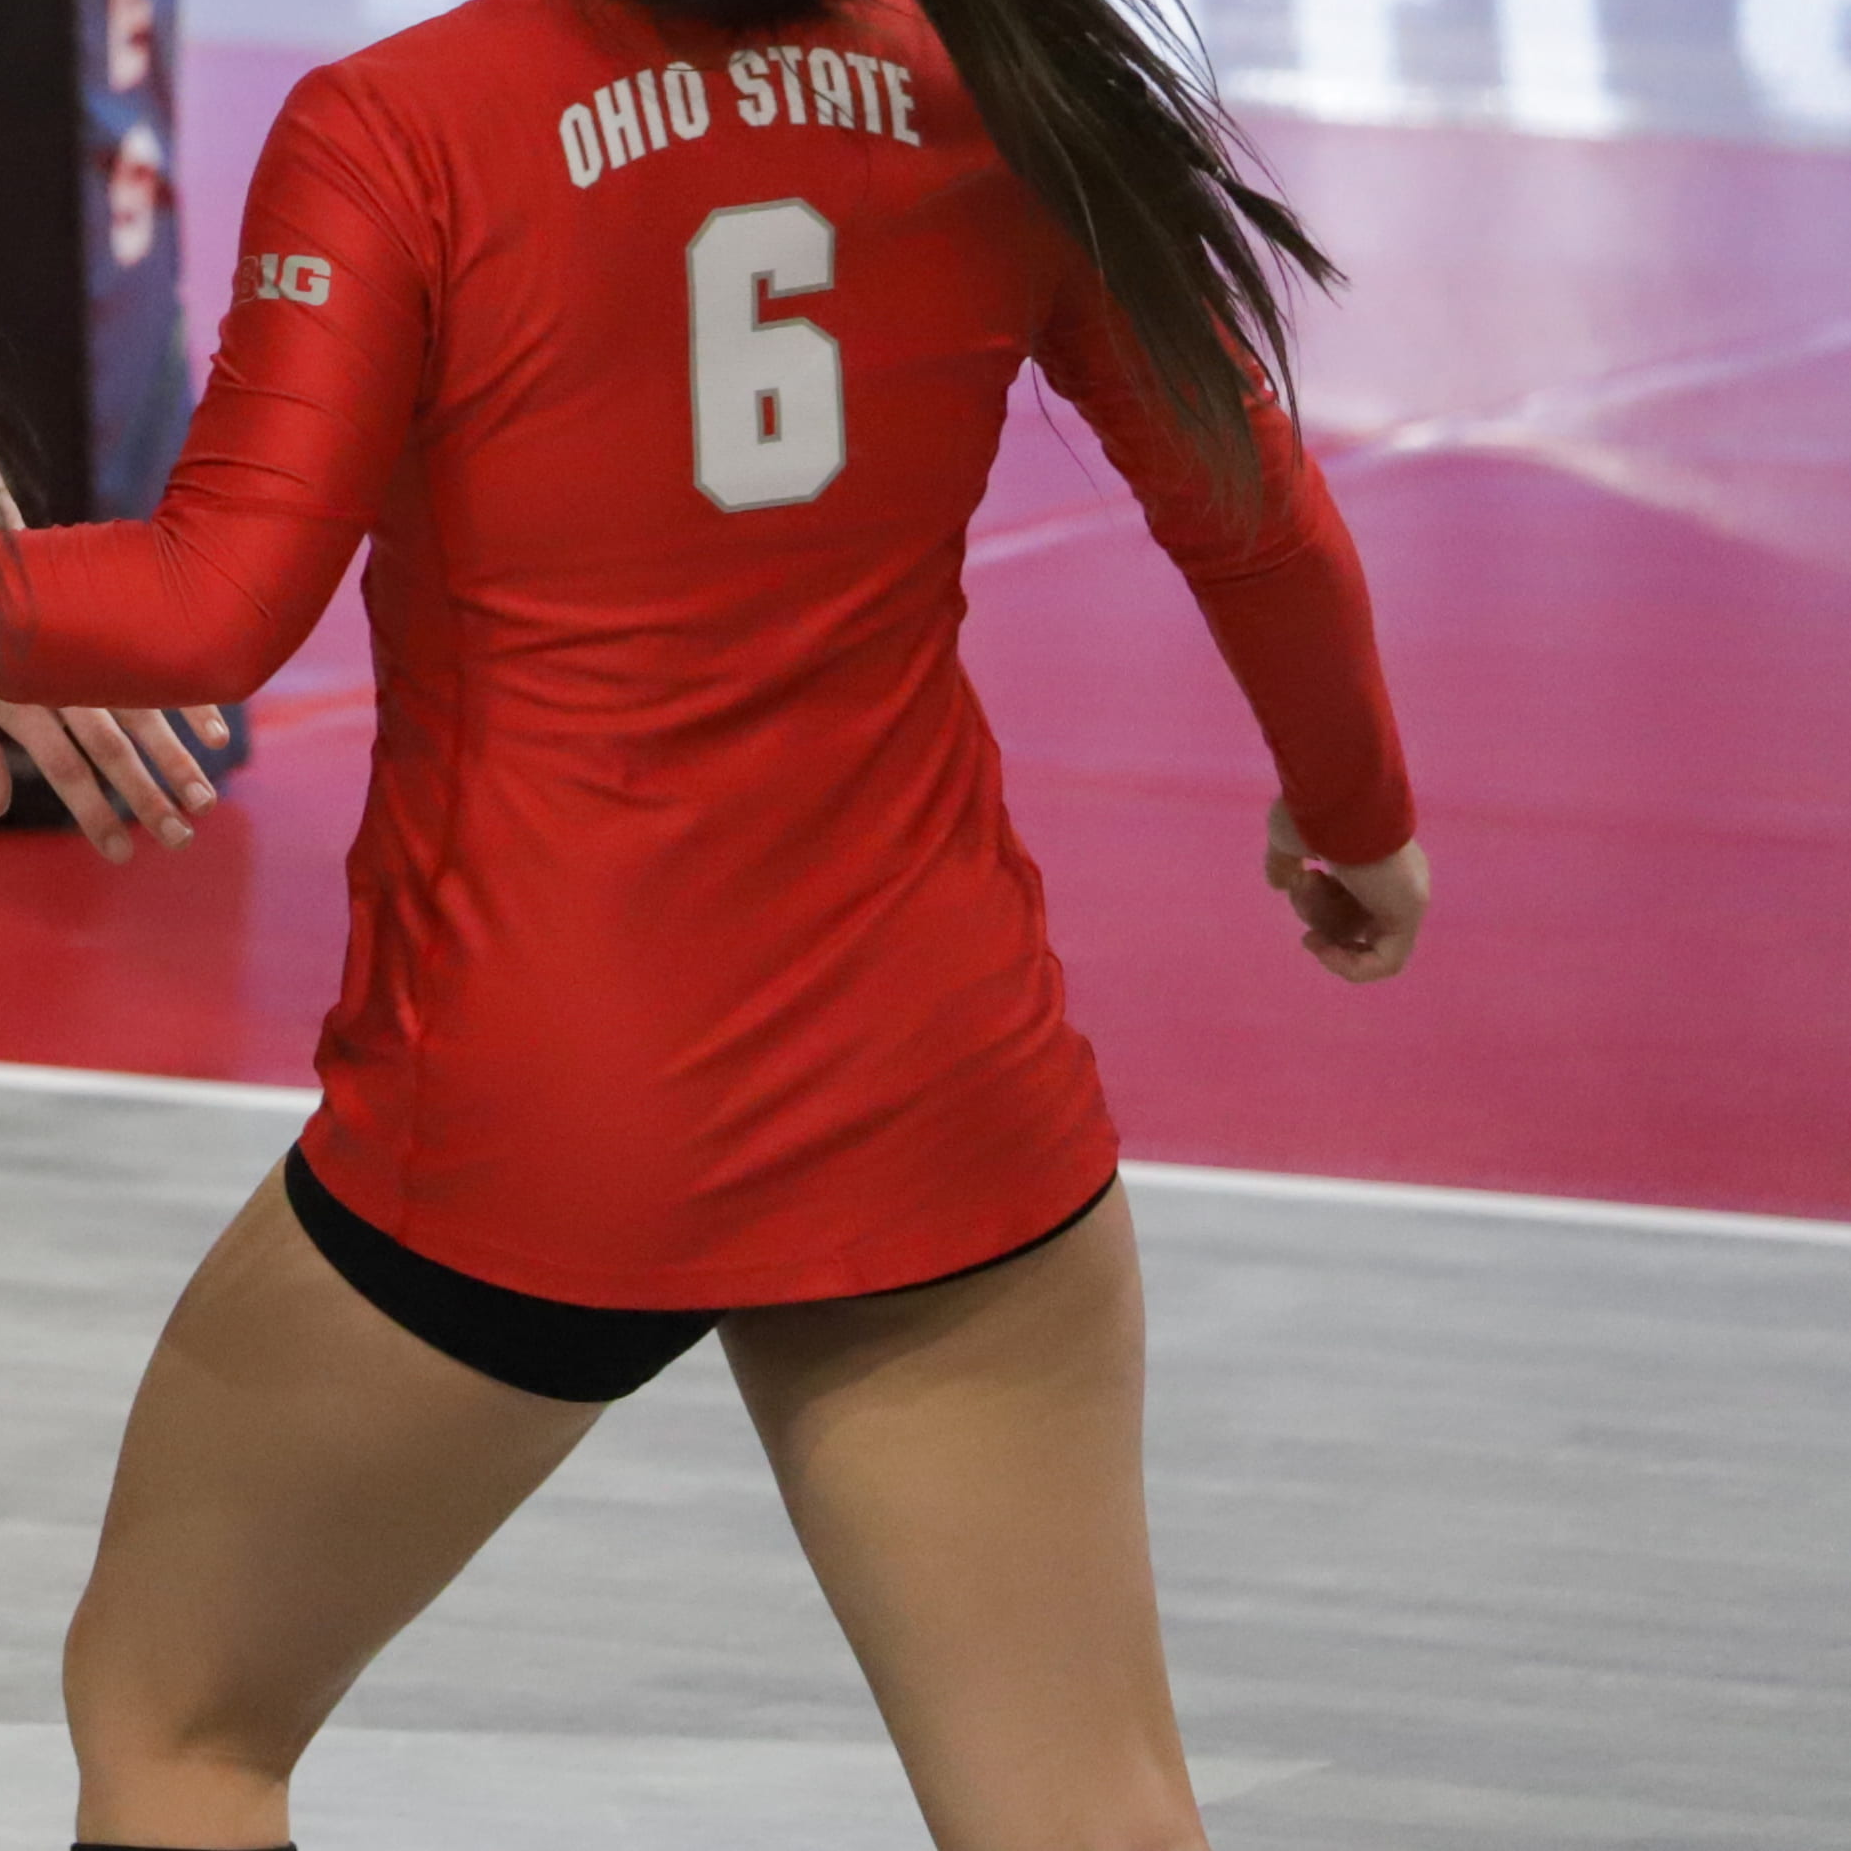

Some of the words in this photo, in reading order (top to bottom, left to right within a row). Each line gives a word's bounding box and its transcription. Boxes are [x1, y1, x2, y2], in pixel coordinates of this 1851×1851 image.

[557, 60, 711, 190] OHIO
[736, 44, 921, 148] STATE
[685, 196, 847, 514] 6
